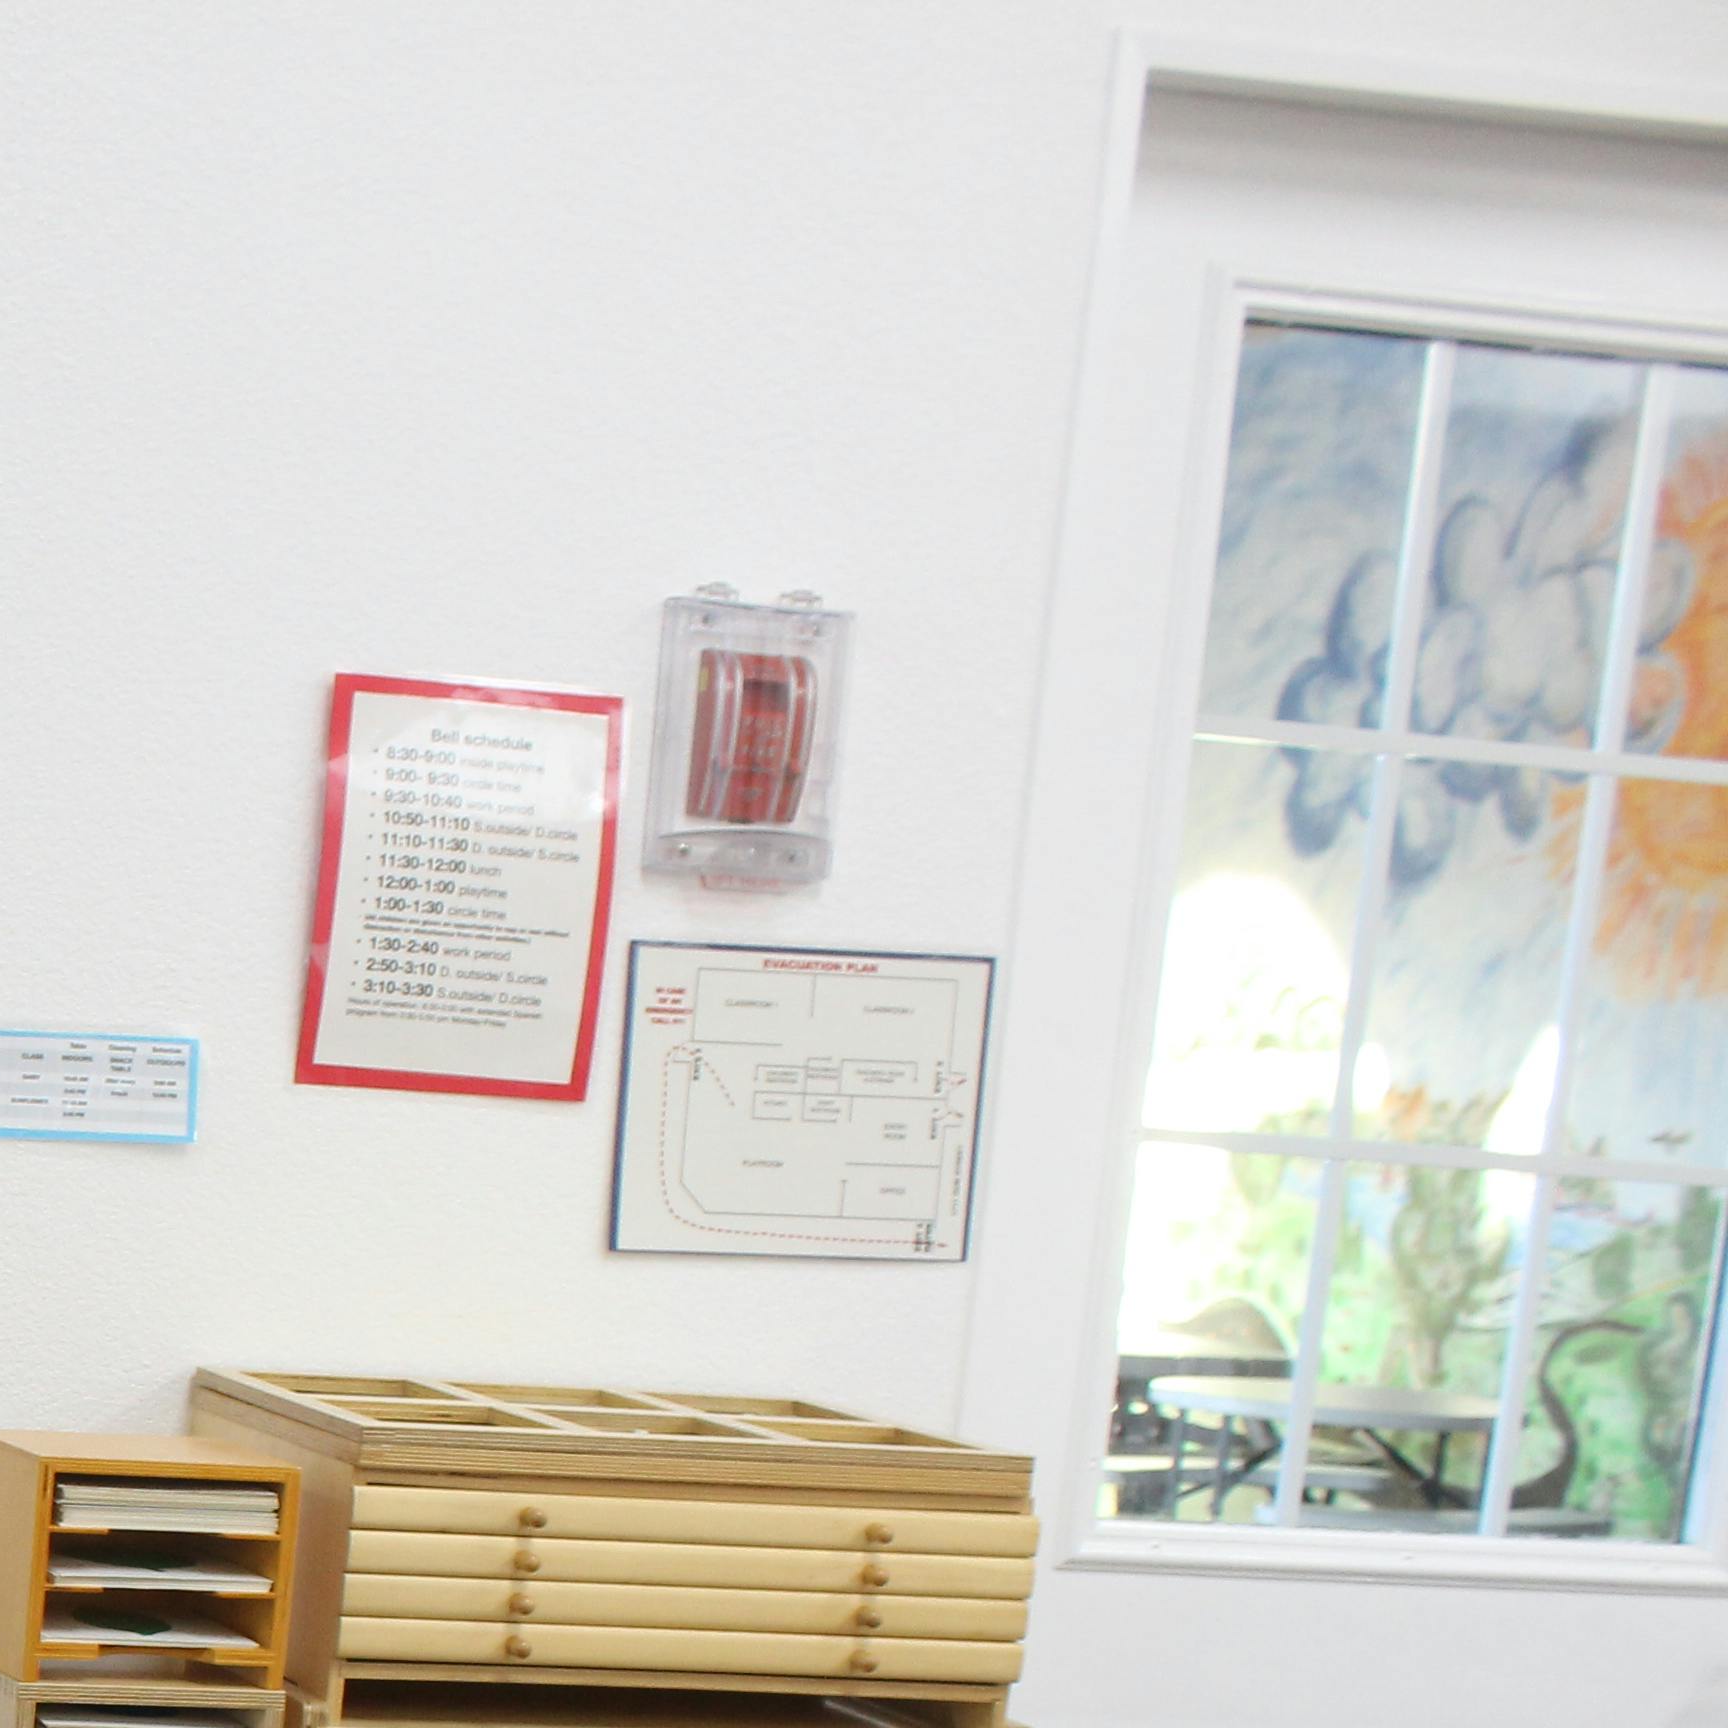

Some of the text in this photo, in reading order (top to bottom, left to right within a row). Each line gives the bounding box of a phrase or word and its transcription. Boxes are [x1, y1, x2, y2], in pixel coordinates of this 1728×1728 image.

[431, 729, 533, 751] Bell schedule
[383, 811, 470, 830] 10:50-11:10
[381, 832, 468, 852] 11:10-11:30
[379, 853, 466, 874] 11:30-12:00
[376, 875, 456, 897] 12:00-1:00
[375, 897, 445, 916] 1:00-1:30
[370, 937, 439, 955] 1:30-2:40
[366, 957, 436, 977] 2:50-3:10
[763, 959, 878, 972] EVACUATION PLAN
[363, 979, 433, 998] 3:10-3:30
